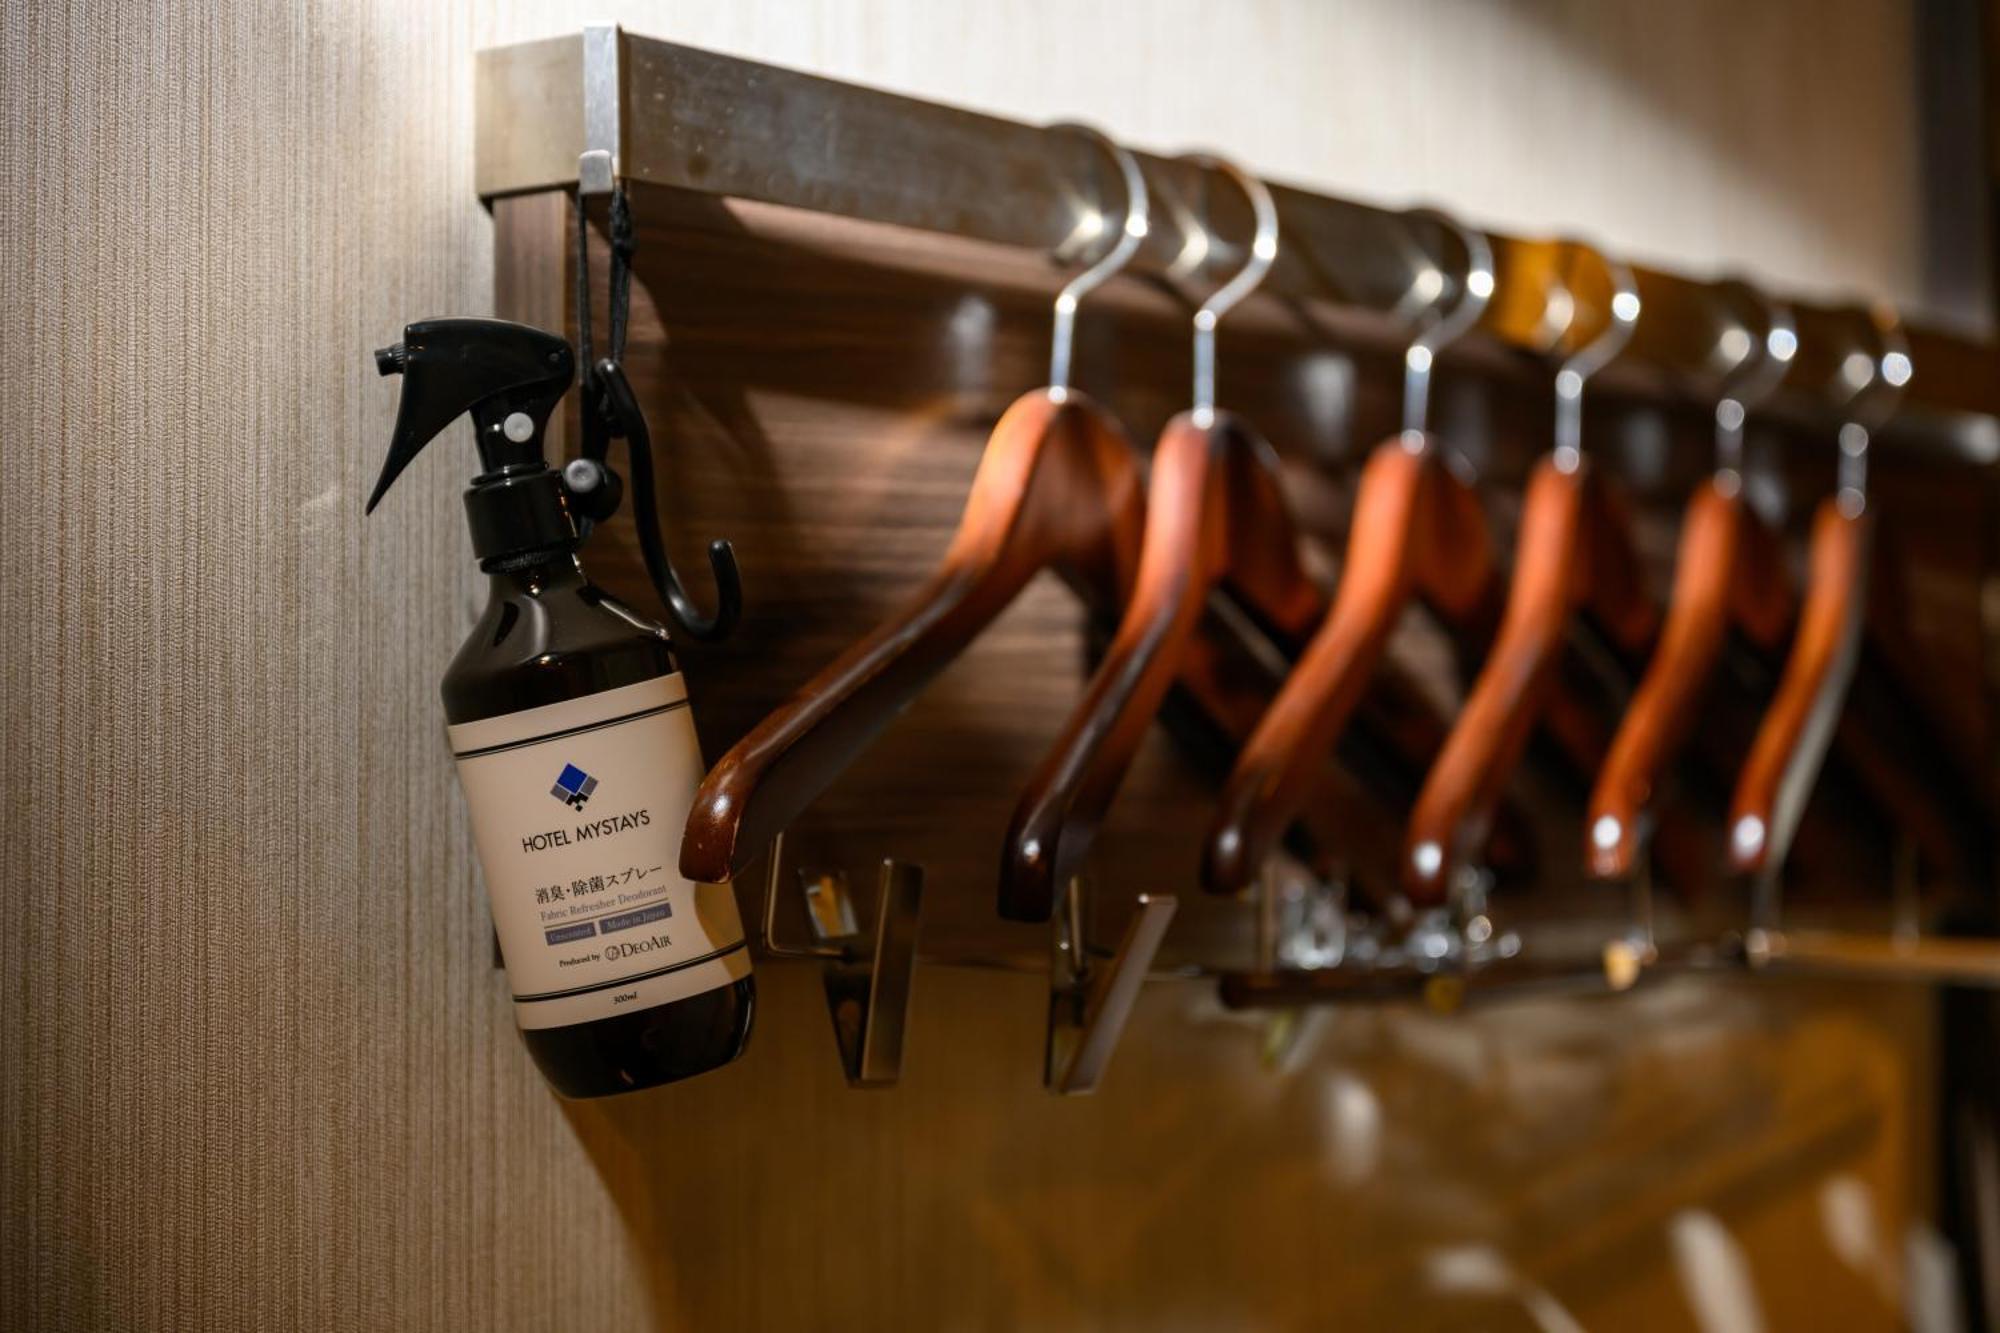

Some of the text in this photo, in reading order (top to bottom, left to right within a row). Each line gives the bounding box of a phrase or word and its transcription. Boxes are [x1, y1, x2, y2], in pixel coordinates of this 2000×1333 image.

[522, 809, 650, 853] HOTEL MYSTAYS
[541, 884, 667, 921] Fabric Refresher Deodorant
[591, 953, 601, 964] by
